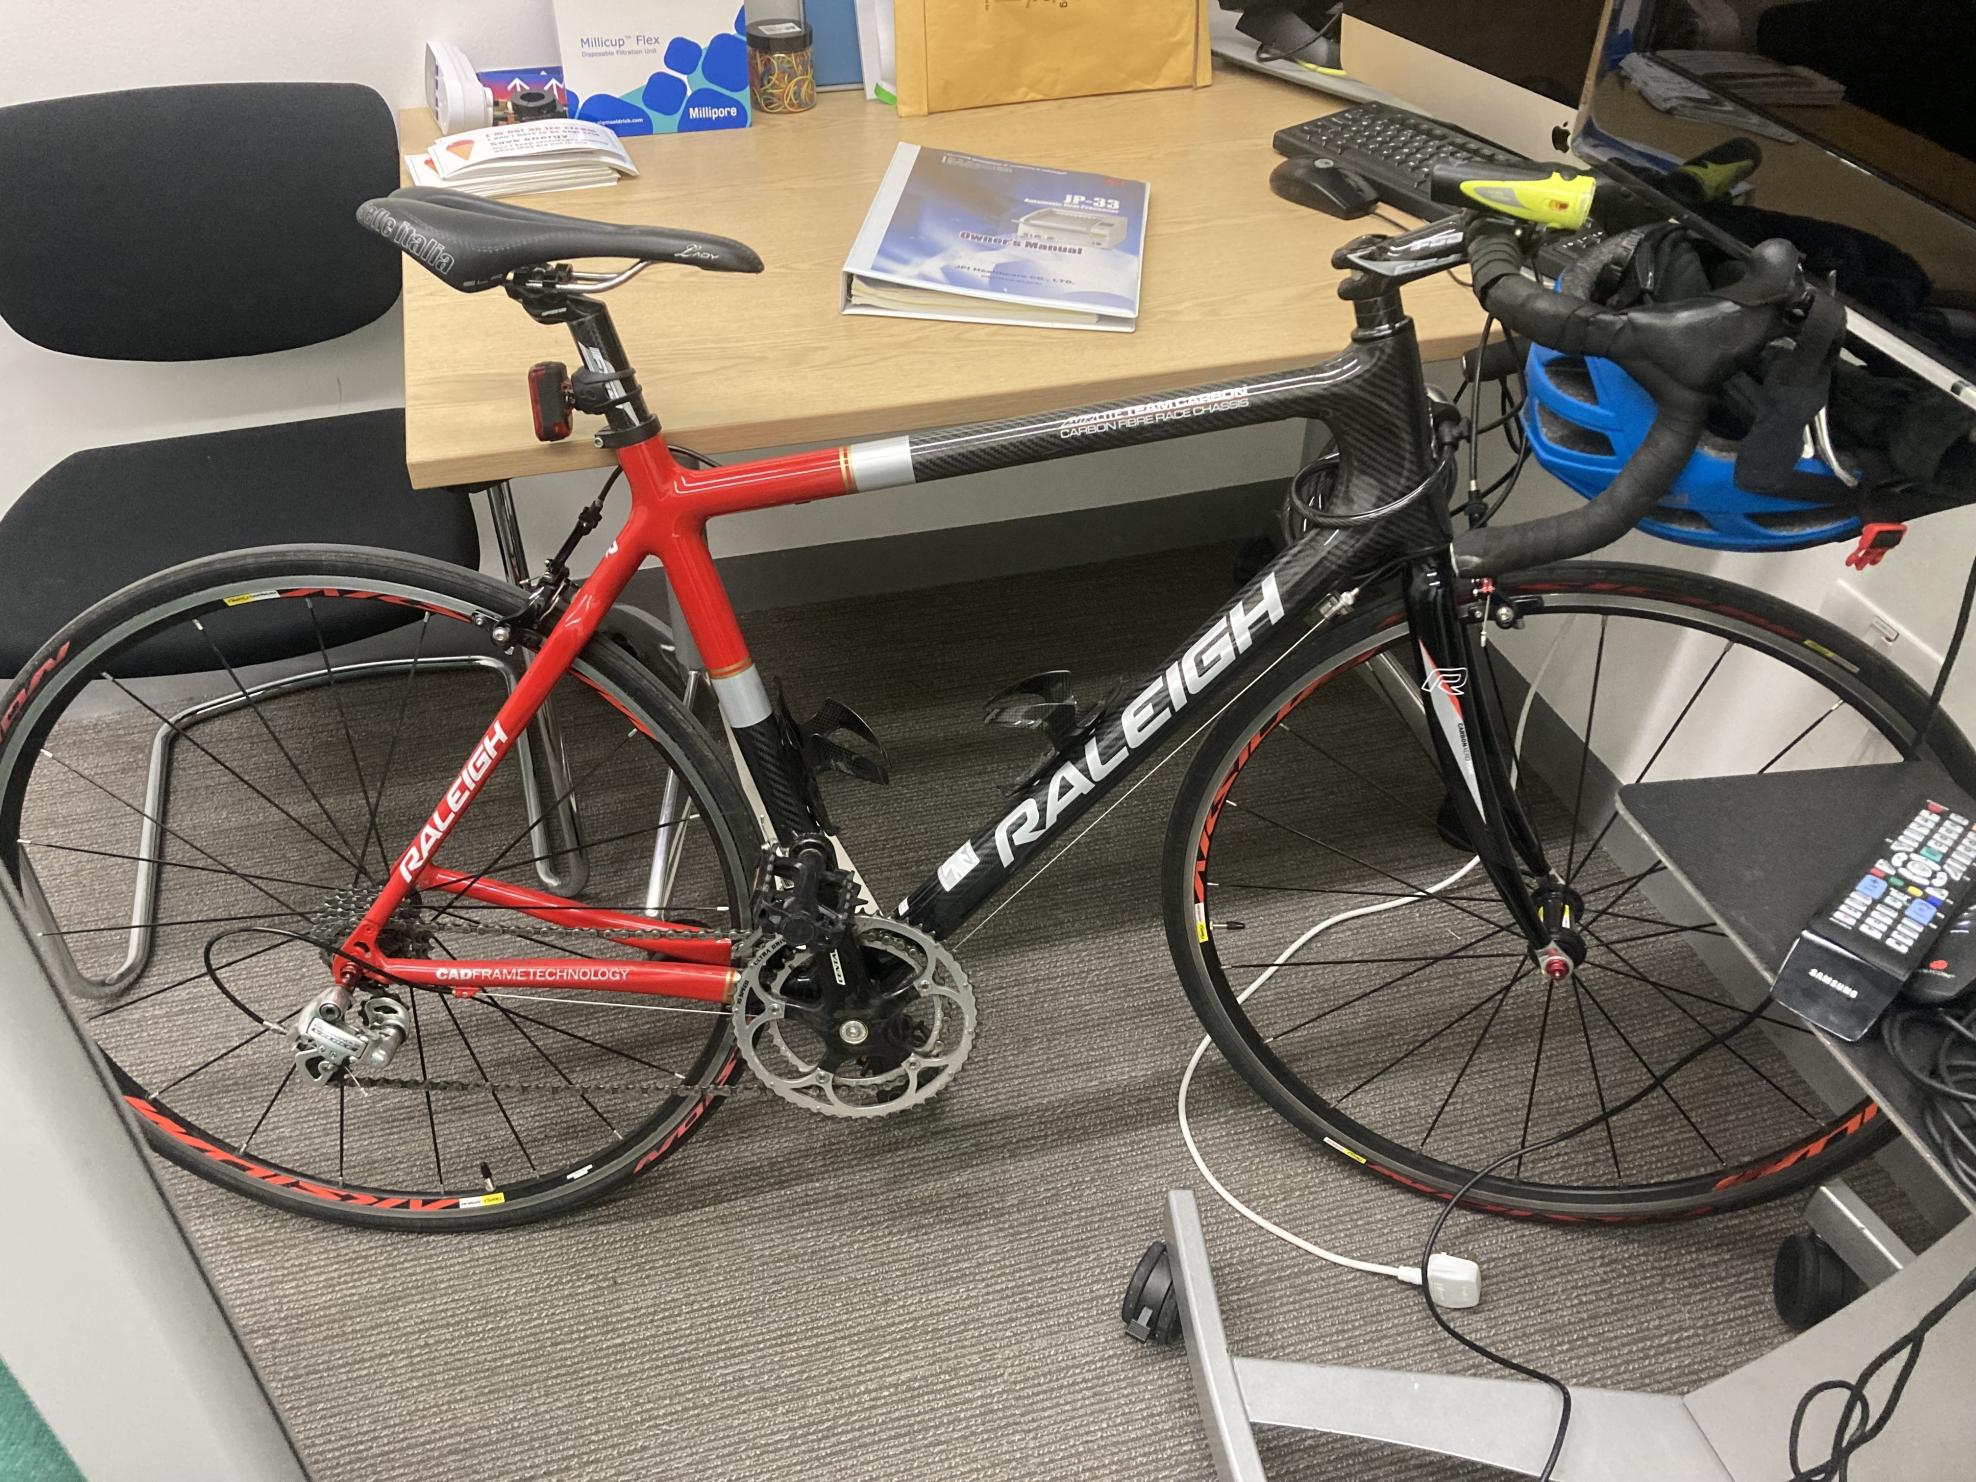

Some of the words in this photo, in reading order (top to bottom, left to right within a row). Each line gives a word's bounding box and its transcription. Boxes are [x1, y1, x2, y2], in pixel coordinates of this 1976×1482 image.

[636, 35, 660, 46] Flex
[581, 50, 614, 58] Disposable
[689, 106, 737, 120] Millipore
[1063, 193, 1120, 210] JP-33
[959, 231, 1021, 248] Owner's
[1024, 240, 1083, 255] Manual
[1060, 421, 1116, 439] CARBON
[1118, 413, 1154, 429] FIBRE
[1155, 407, 1193, 422] RACE
[1192, 398, 1250, 416] CHASSIS
[1124, 399, 1172, 418] TEAM
[995, 571, 1285, 869] RALEIGH
[399, 719, 508, 884] RALEIGH
[1808, 967, 1859, 1000] SAMSUNG
